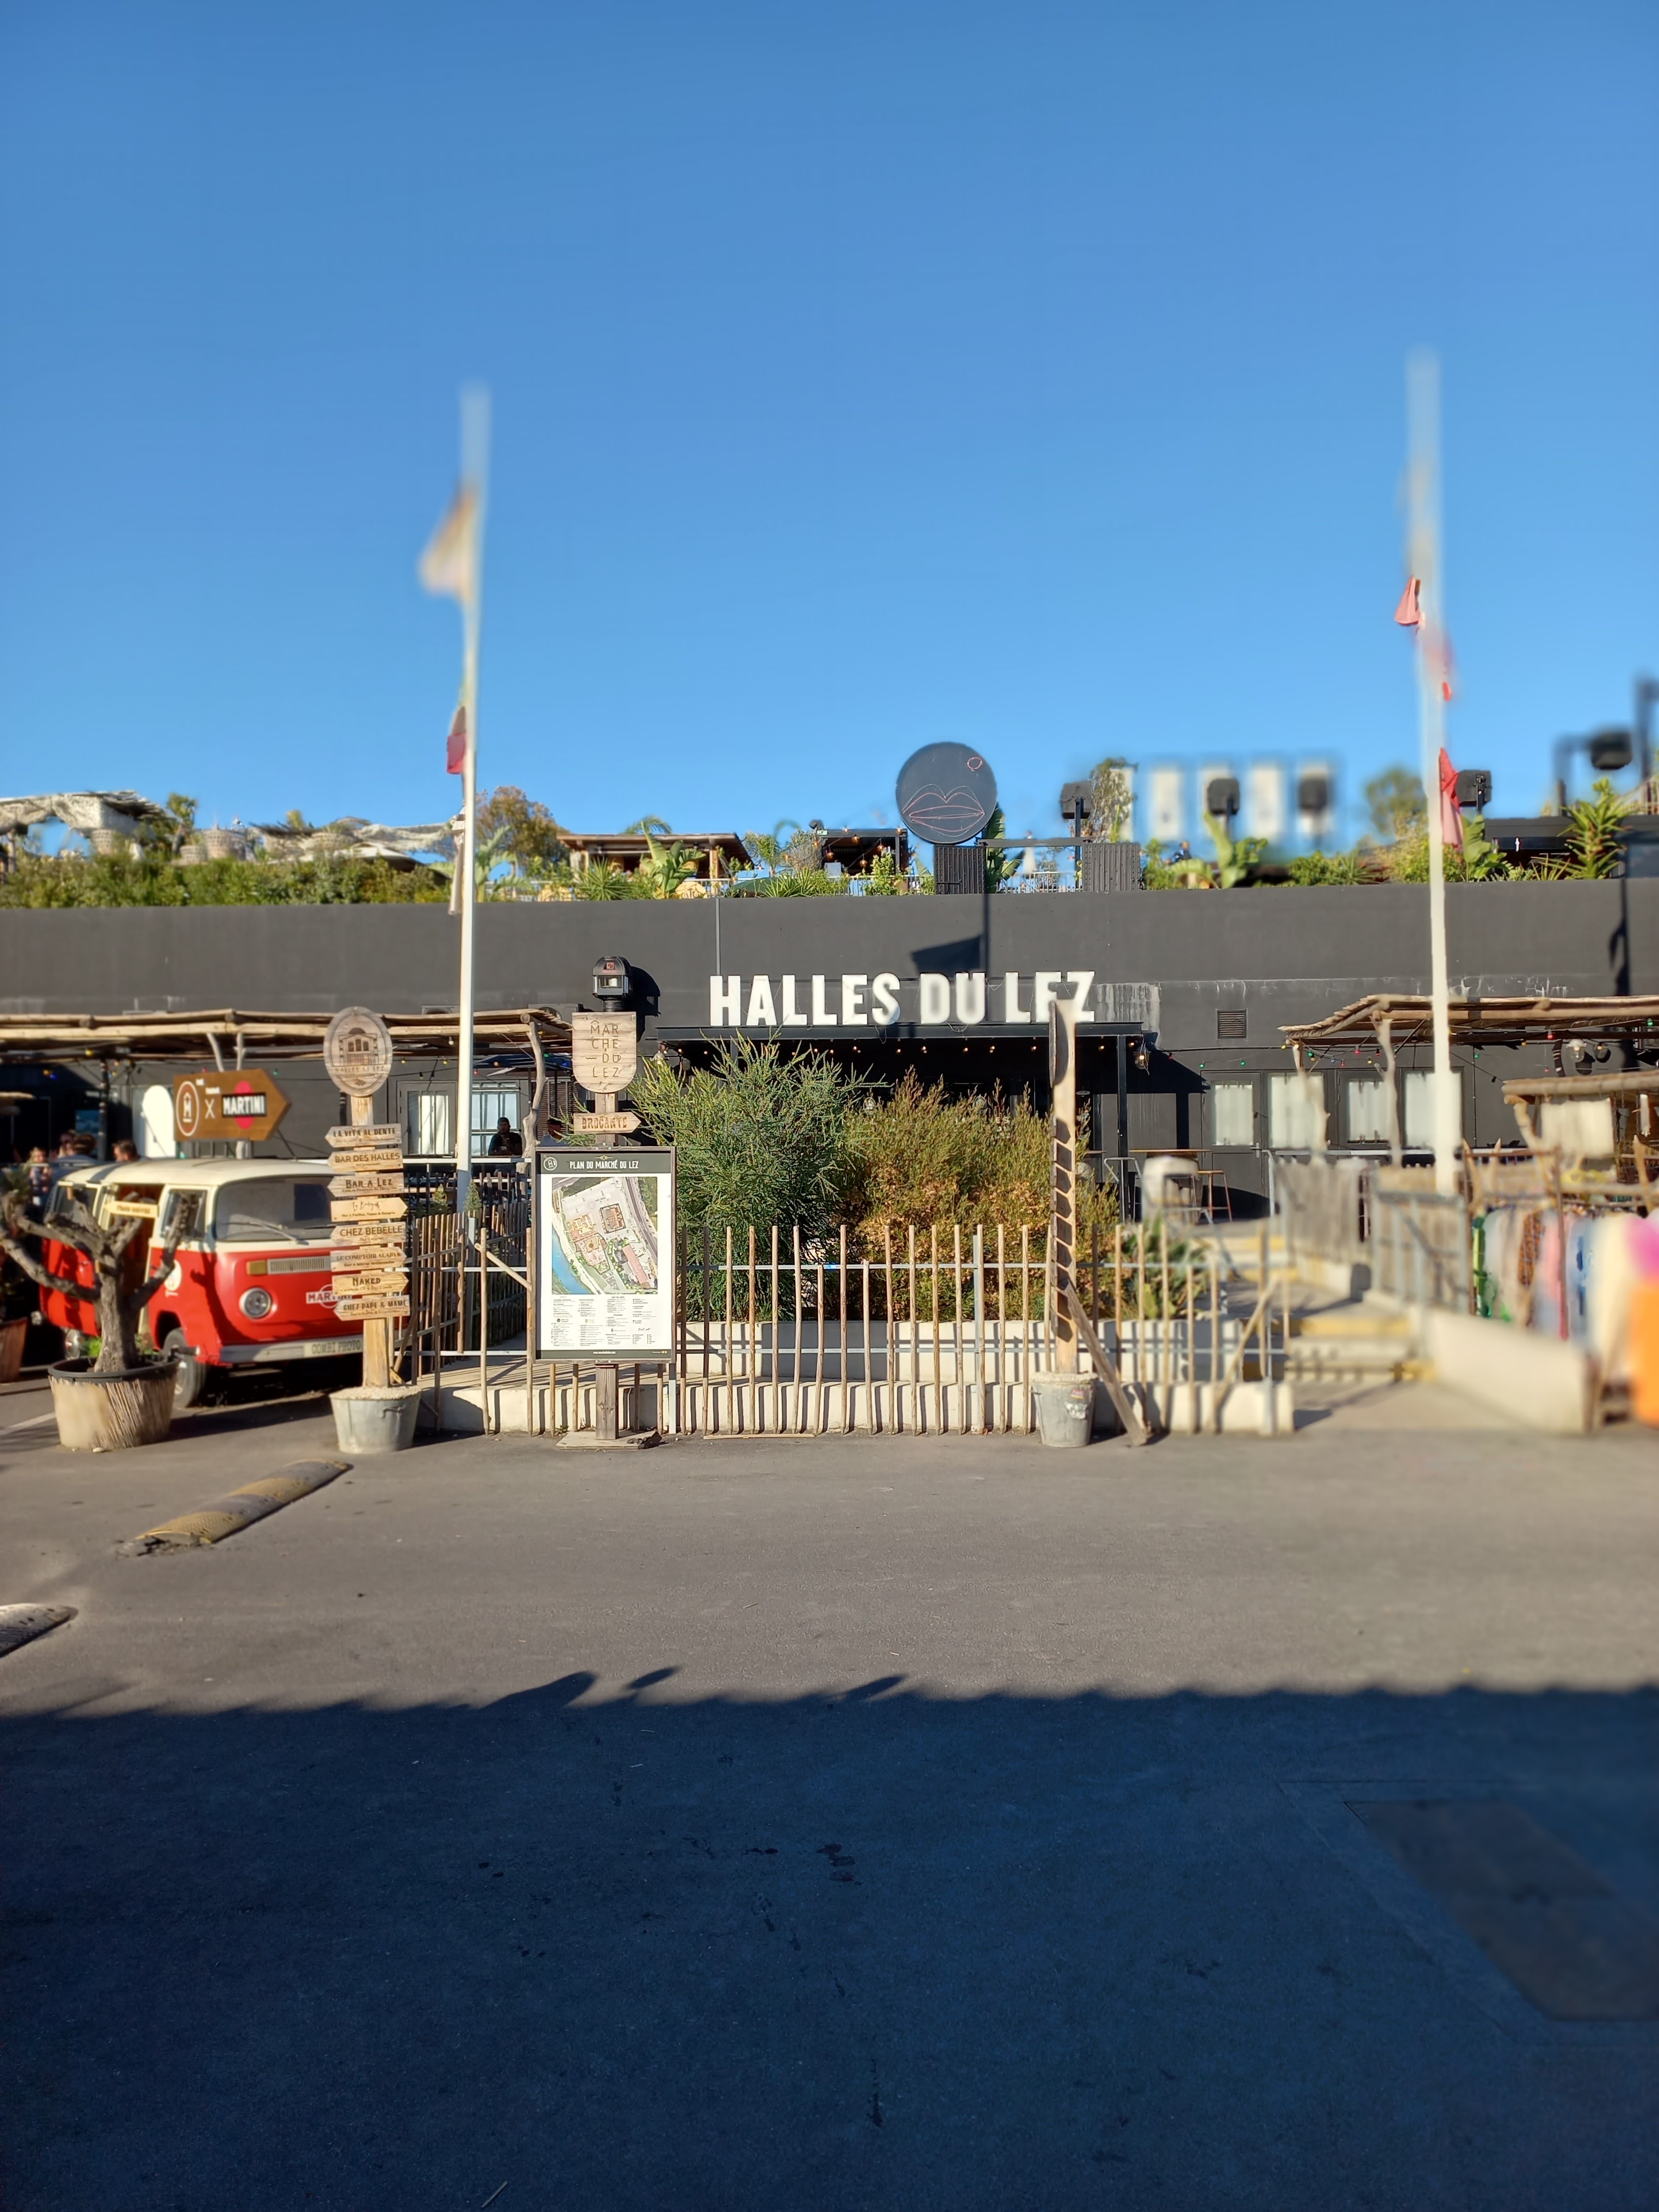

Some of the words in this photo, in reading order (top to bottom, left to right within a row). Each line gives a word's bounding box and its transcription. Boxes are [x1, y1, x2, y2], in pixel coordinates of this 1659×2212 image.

[710, 973, 900, 1026] HALLES
[920, 972, 985, 1025] DU
[1006, 972, 1095, 1023] LEZ
[591, 1024, 619, 1035] MAR
[602, 1053, 621, 1063] DU
[593, 1067, 619, 1078] LEZ
[223, 1095, 265, 1115] MARTINI
[582, 1116, 628, 1129] BROCANTE
[374, 1127, 397, 1135] DENTE
[353, 1154, 369, 1162] DES
[371, 1153, 400, 1161] HALLES
[570, 1161, 585, 1169] PLAN
[596, 1159, 618, 1169] MARCHÉ
[629, 1161, 639, 1169] LEZ
[340, 1228, 363, 1237] CHEZ
[365, 1225, 402, 1235] BEBELLE
[312, 1342, 335, 1354] COMBI
[338, 1339, 361, 1352] PHOTO
